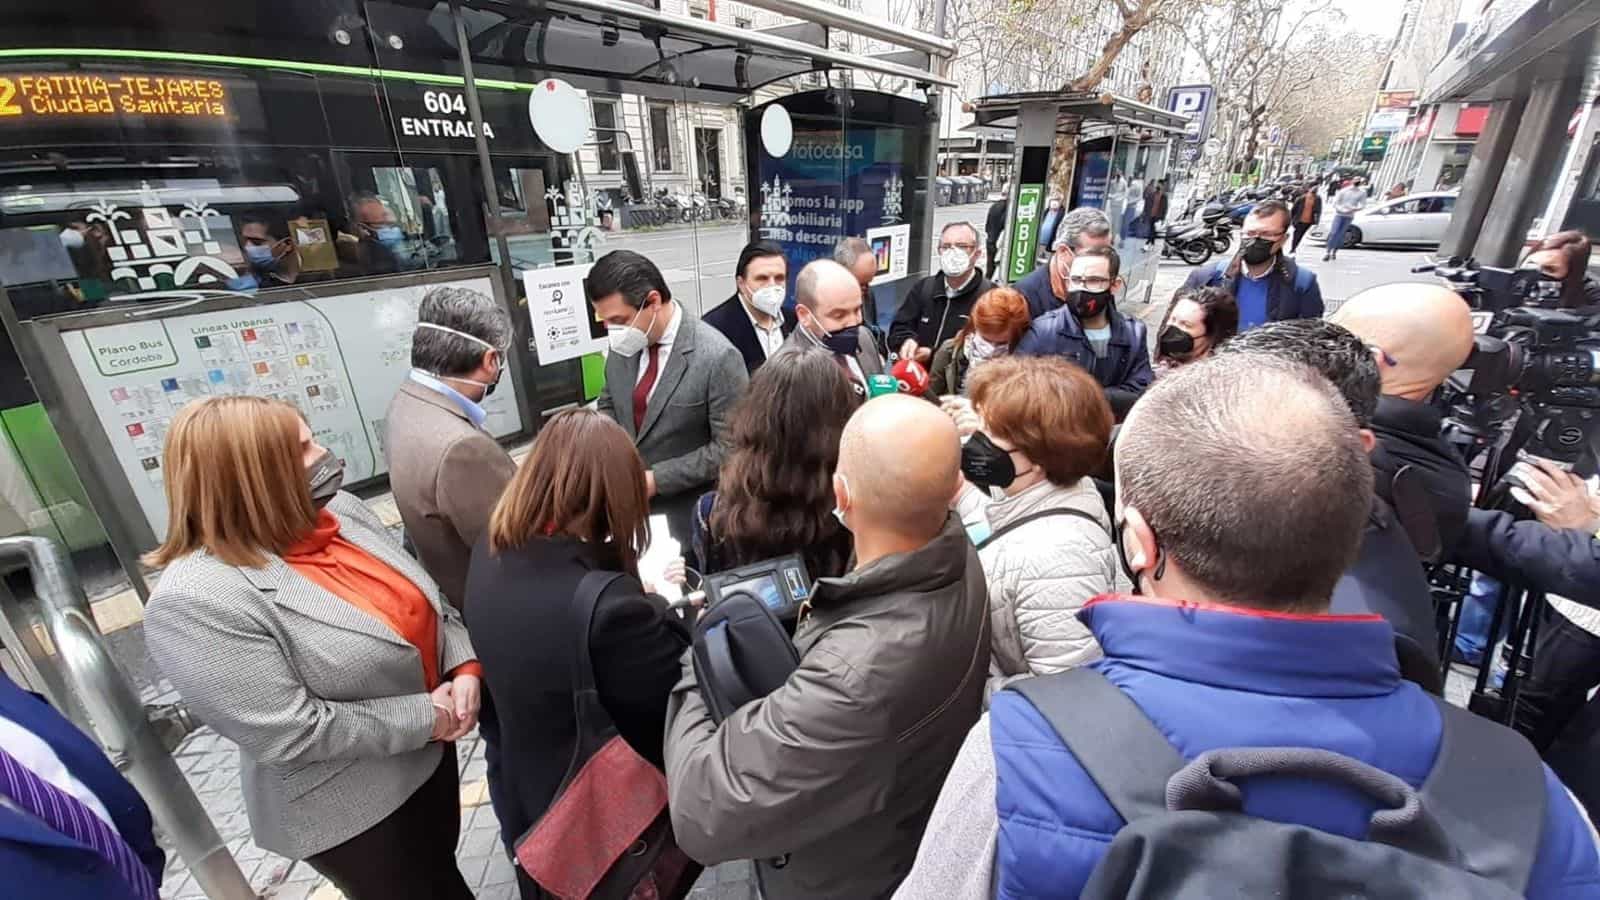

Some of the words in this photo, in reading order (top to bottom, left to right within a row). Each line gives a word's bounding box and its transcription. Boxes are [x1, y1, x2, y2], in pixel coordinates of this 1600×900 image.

[18, 76, 225, 98] FATIMA-TEJARES
[30, 95, 114, 113] Ciudad
[119, 95, 225, 115] Sanitaria
[423, 91, 467, 115] 604
[1175, 92, 1202, 113] P
[792, 141, 864, 160] fotocasa
[824, 195, 836, 209] la
[840, 199, 865, 214] app
[1015, 223, 1030, 274] BUS
[230, 317, 274, 328] Urbanas
[98, 344, 137, 356] Plano
[139, 340, 163, 350] Bus
